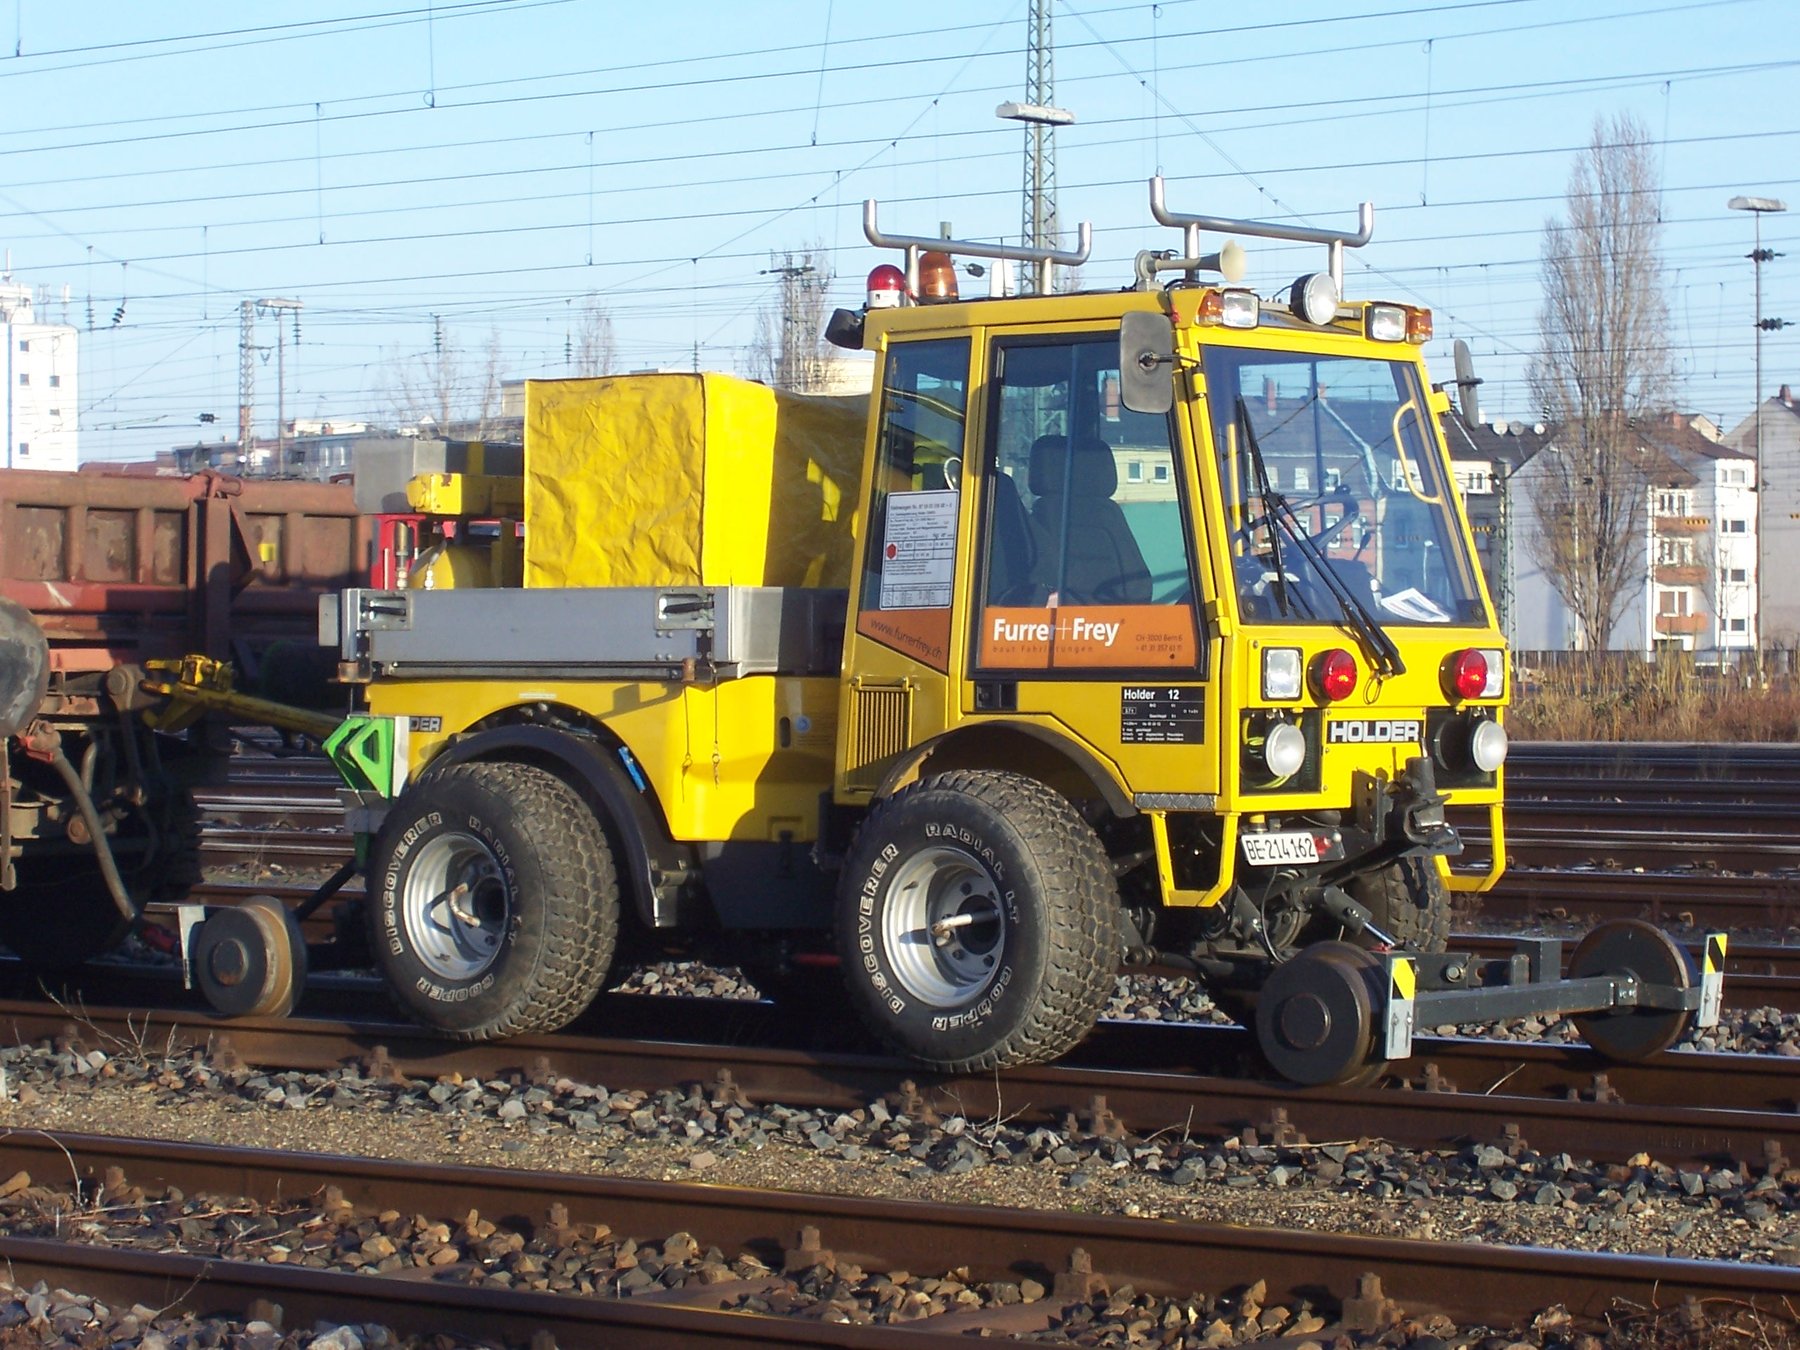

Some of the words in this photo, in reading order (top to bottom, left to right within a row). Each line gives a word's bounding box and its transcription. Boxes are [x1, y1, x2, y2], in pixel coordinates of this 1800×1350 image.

[1123, 688, 1156, 700] Holder
[1167, 689, 1180, 700] 12
[1330, 720, 1420, 743] HOLDER
[468, 815, 520, 898] RADIAL
[925, 822, 1004, 881] RADIAL
[383, 811, 443, 956] DISCOVERER
[858, 843, 906, 1014] DISCOVERER
[415, 972, 494, 1002] COOPER
[931, 965, 1013, 1032] COOPER
